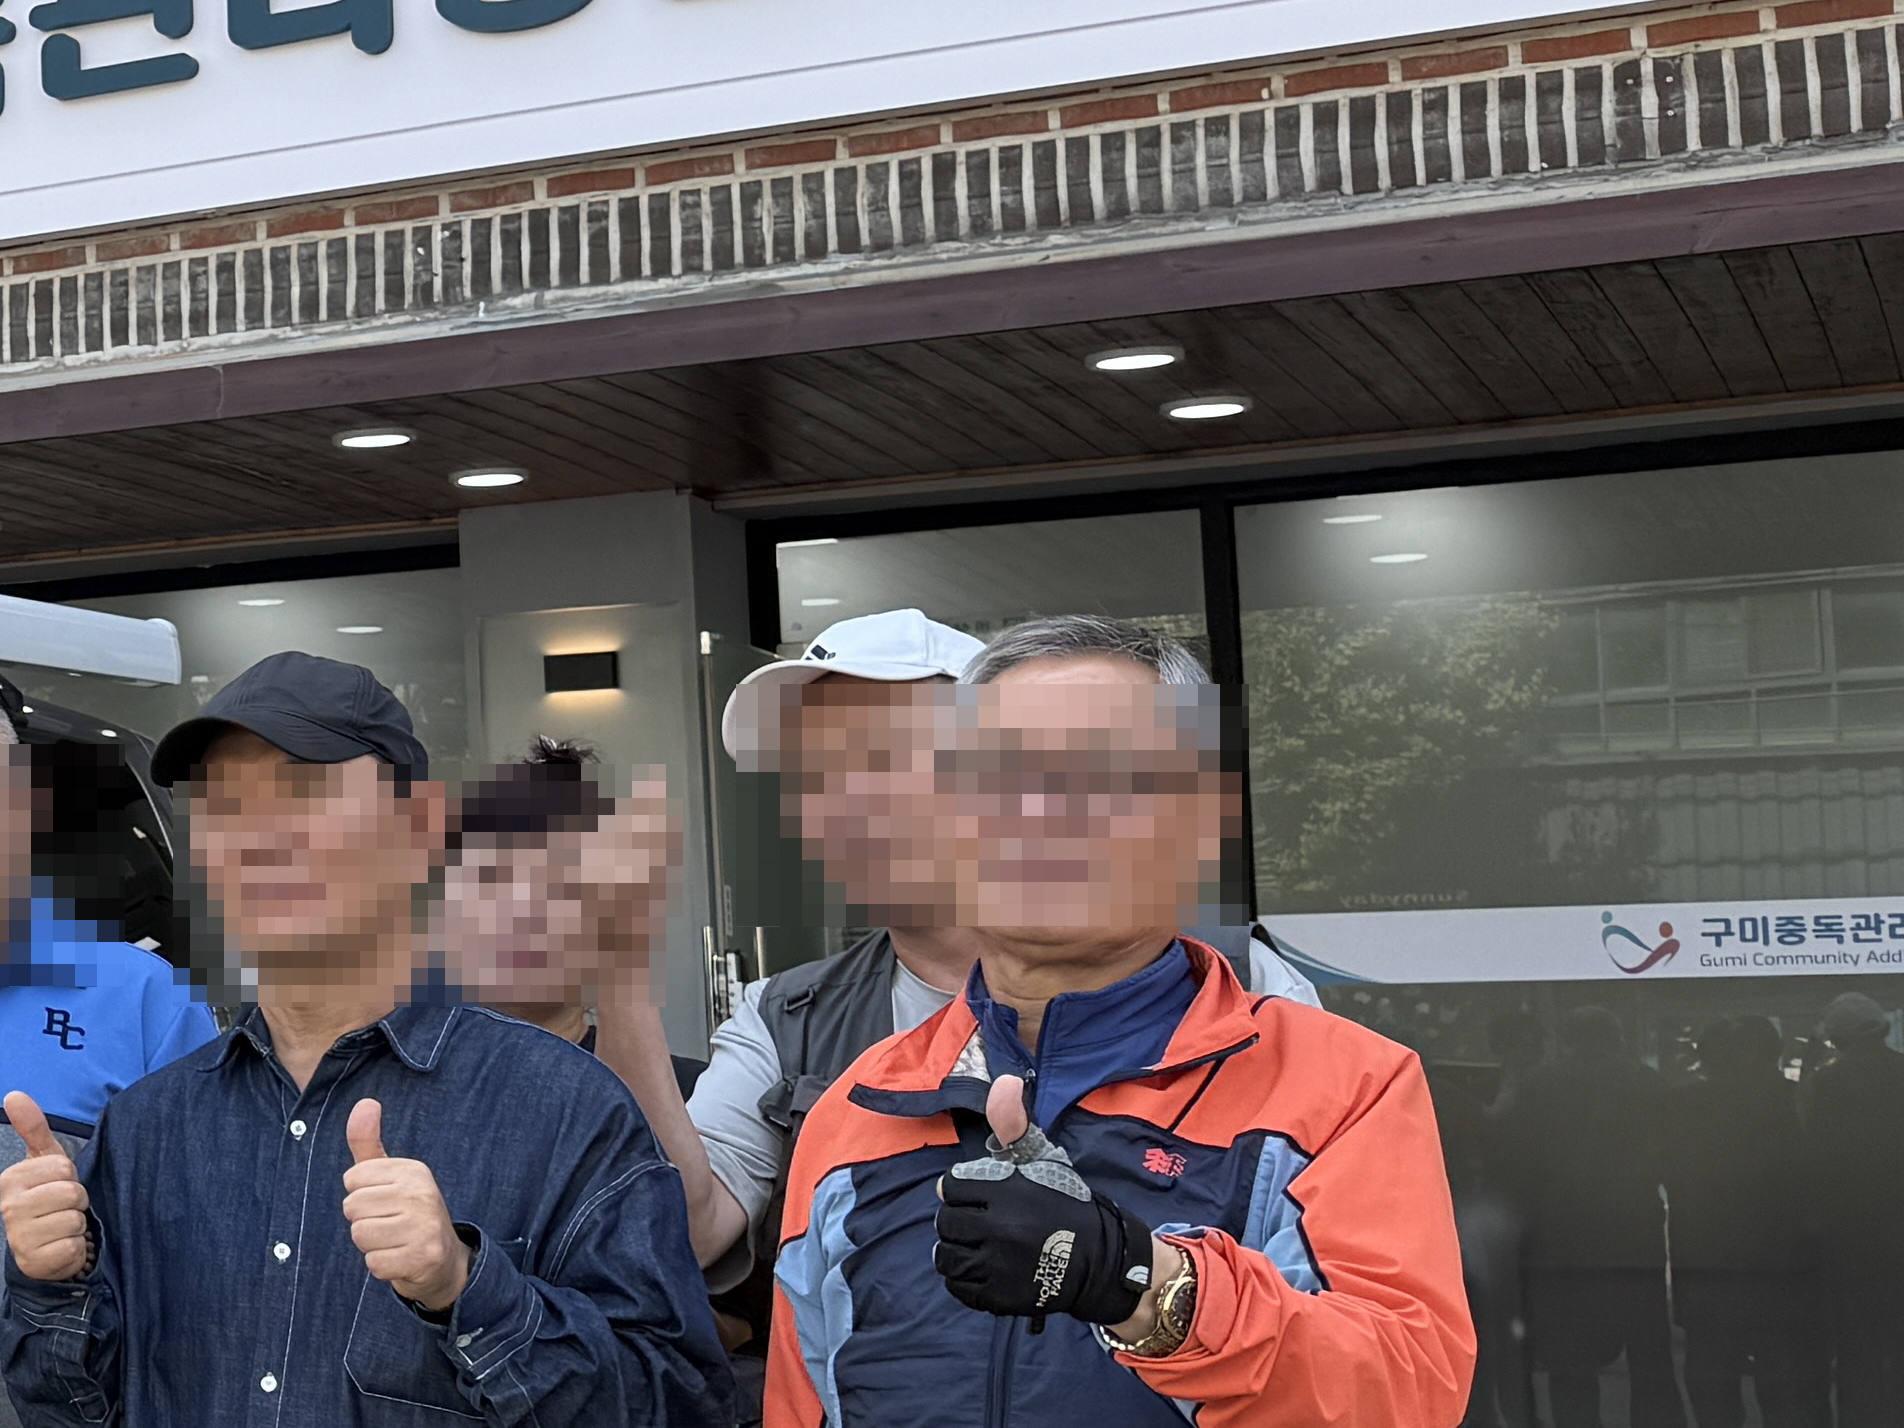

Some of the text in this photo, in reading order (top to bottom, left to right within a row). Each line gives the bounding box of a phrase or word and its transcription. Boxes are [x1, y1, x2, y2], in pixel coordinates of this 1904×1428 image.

[1700, 949, 1904, 967] Gumi Community Add
